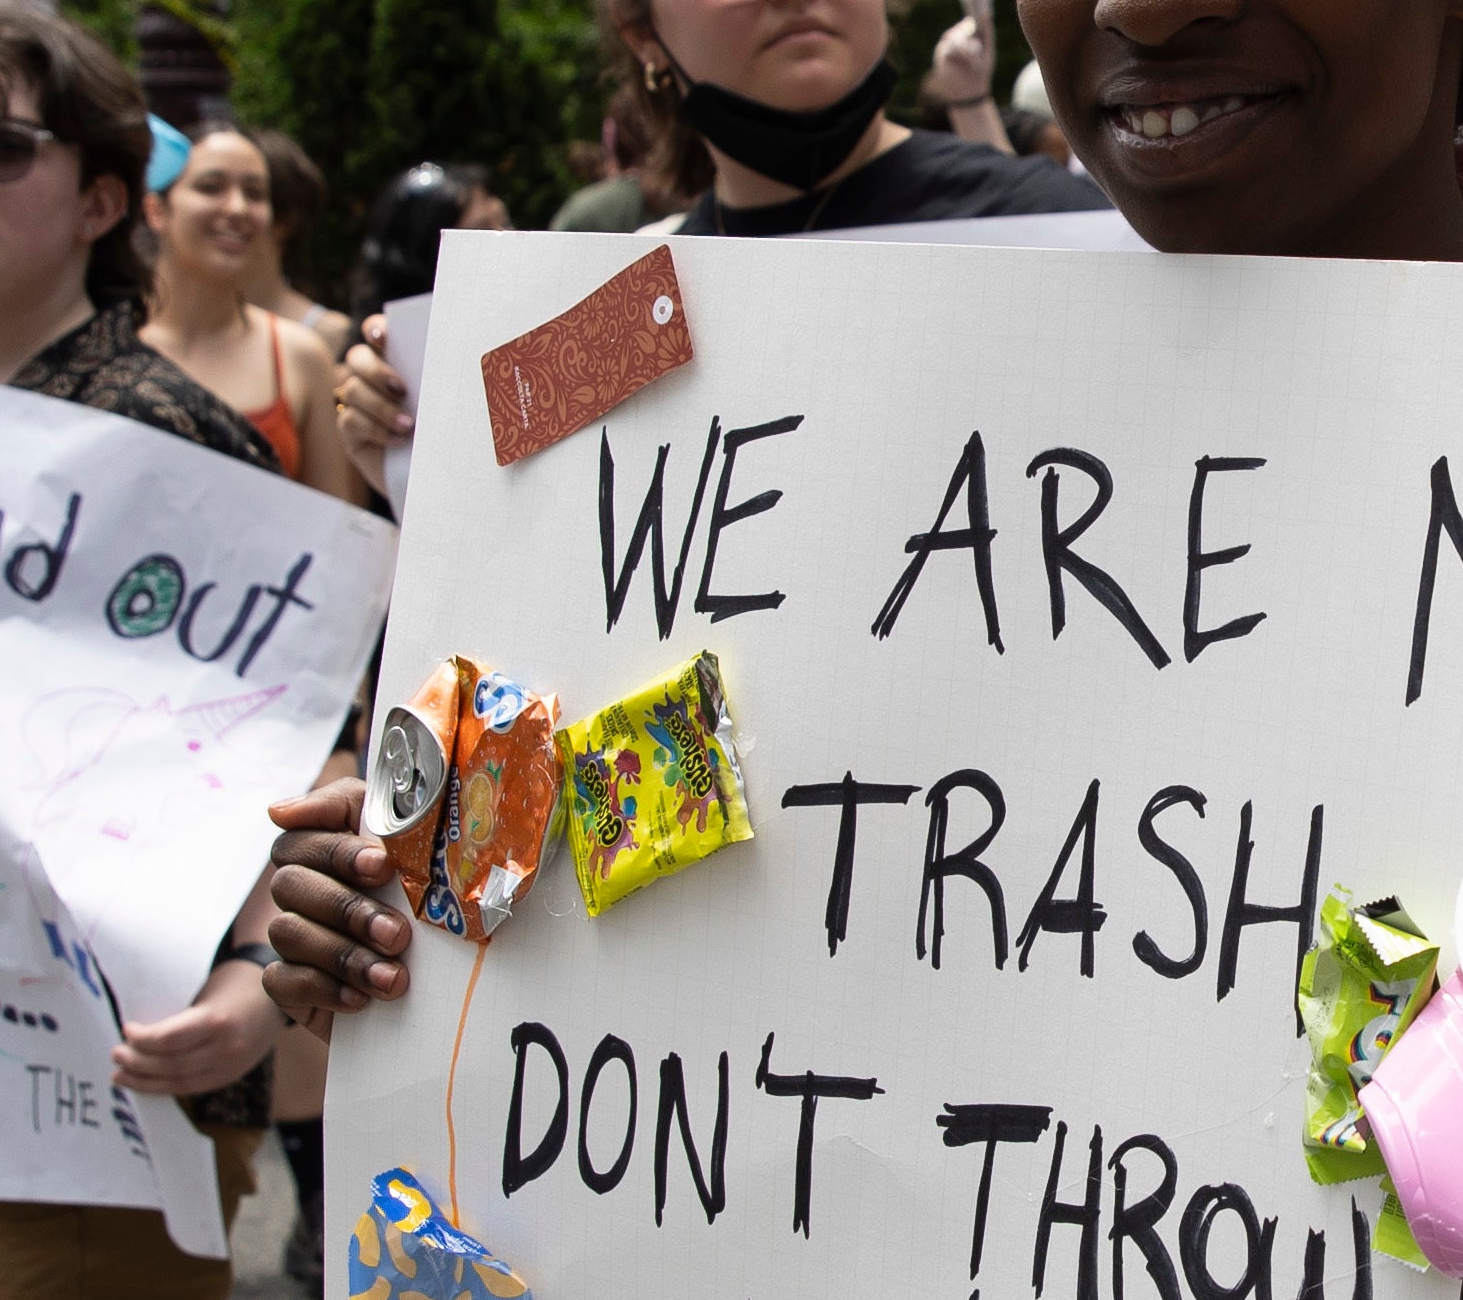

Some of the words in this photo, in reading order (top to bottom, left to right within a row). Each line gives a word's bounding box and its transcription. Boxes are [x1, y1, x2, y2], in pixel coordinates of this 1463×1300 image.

[598, 414, 805, 641] WE
[871, 430, 1267, 669] ARE
[105, 550, 316, 677] out
[581, 760, 624, 846] Gushers
[667, 711, 714, 798] Gushers
[781, 767, 1324, 1038] TRASH
[25, 1064, 101, 1133] THE
[502, 1021, 886, 1239] DON'T
